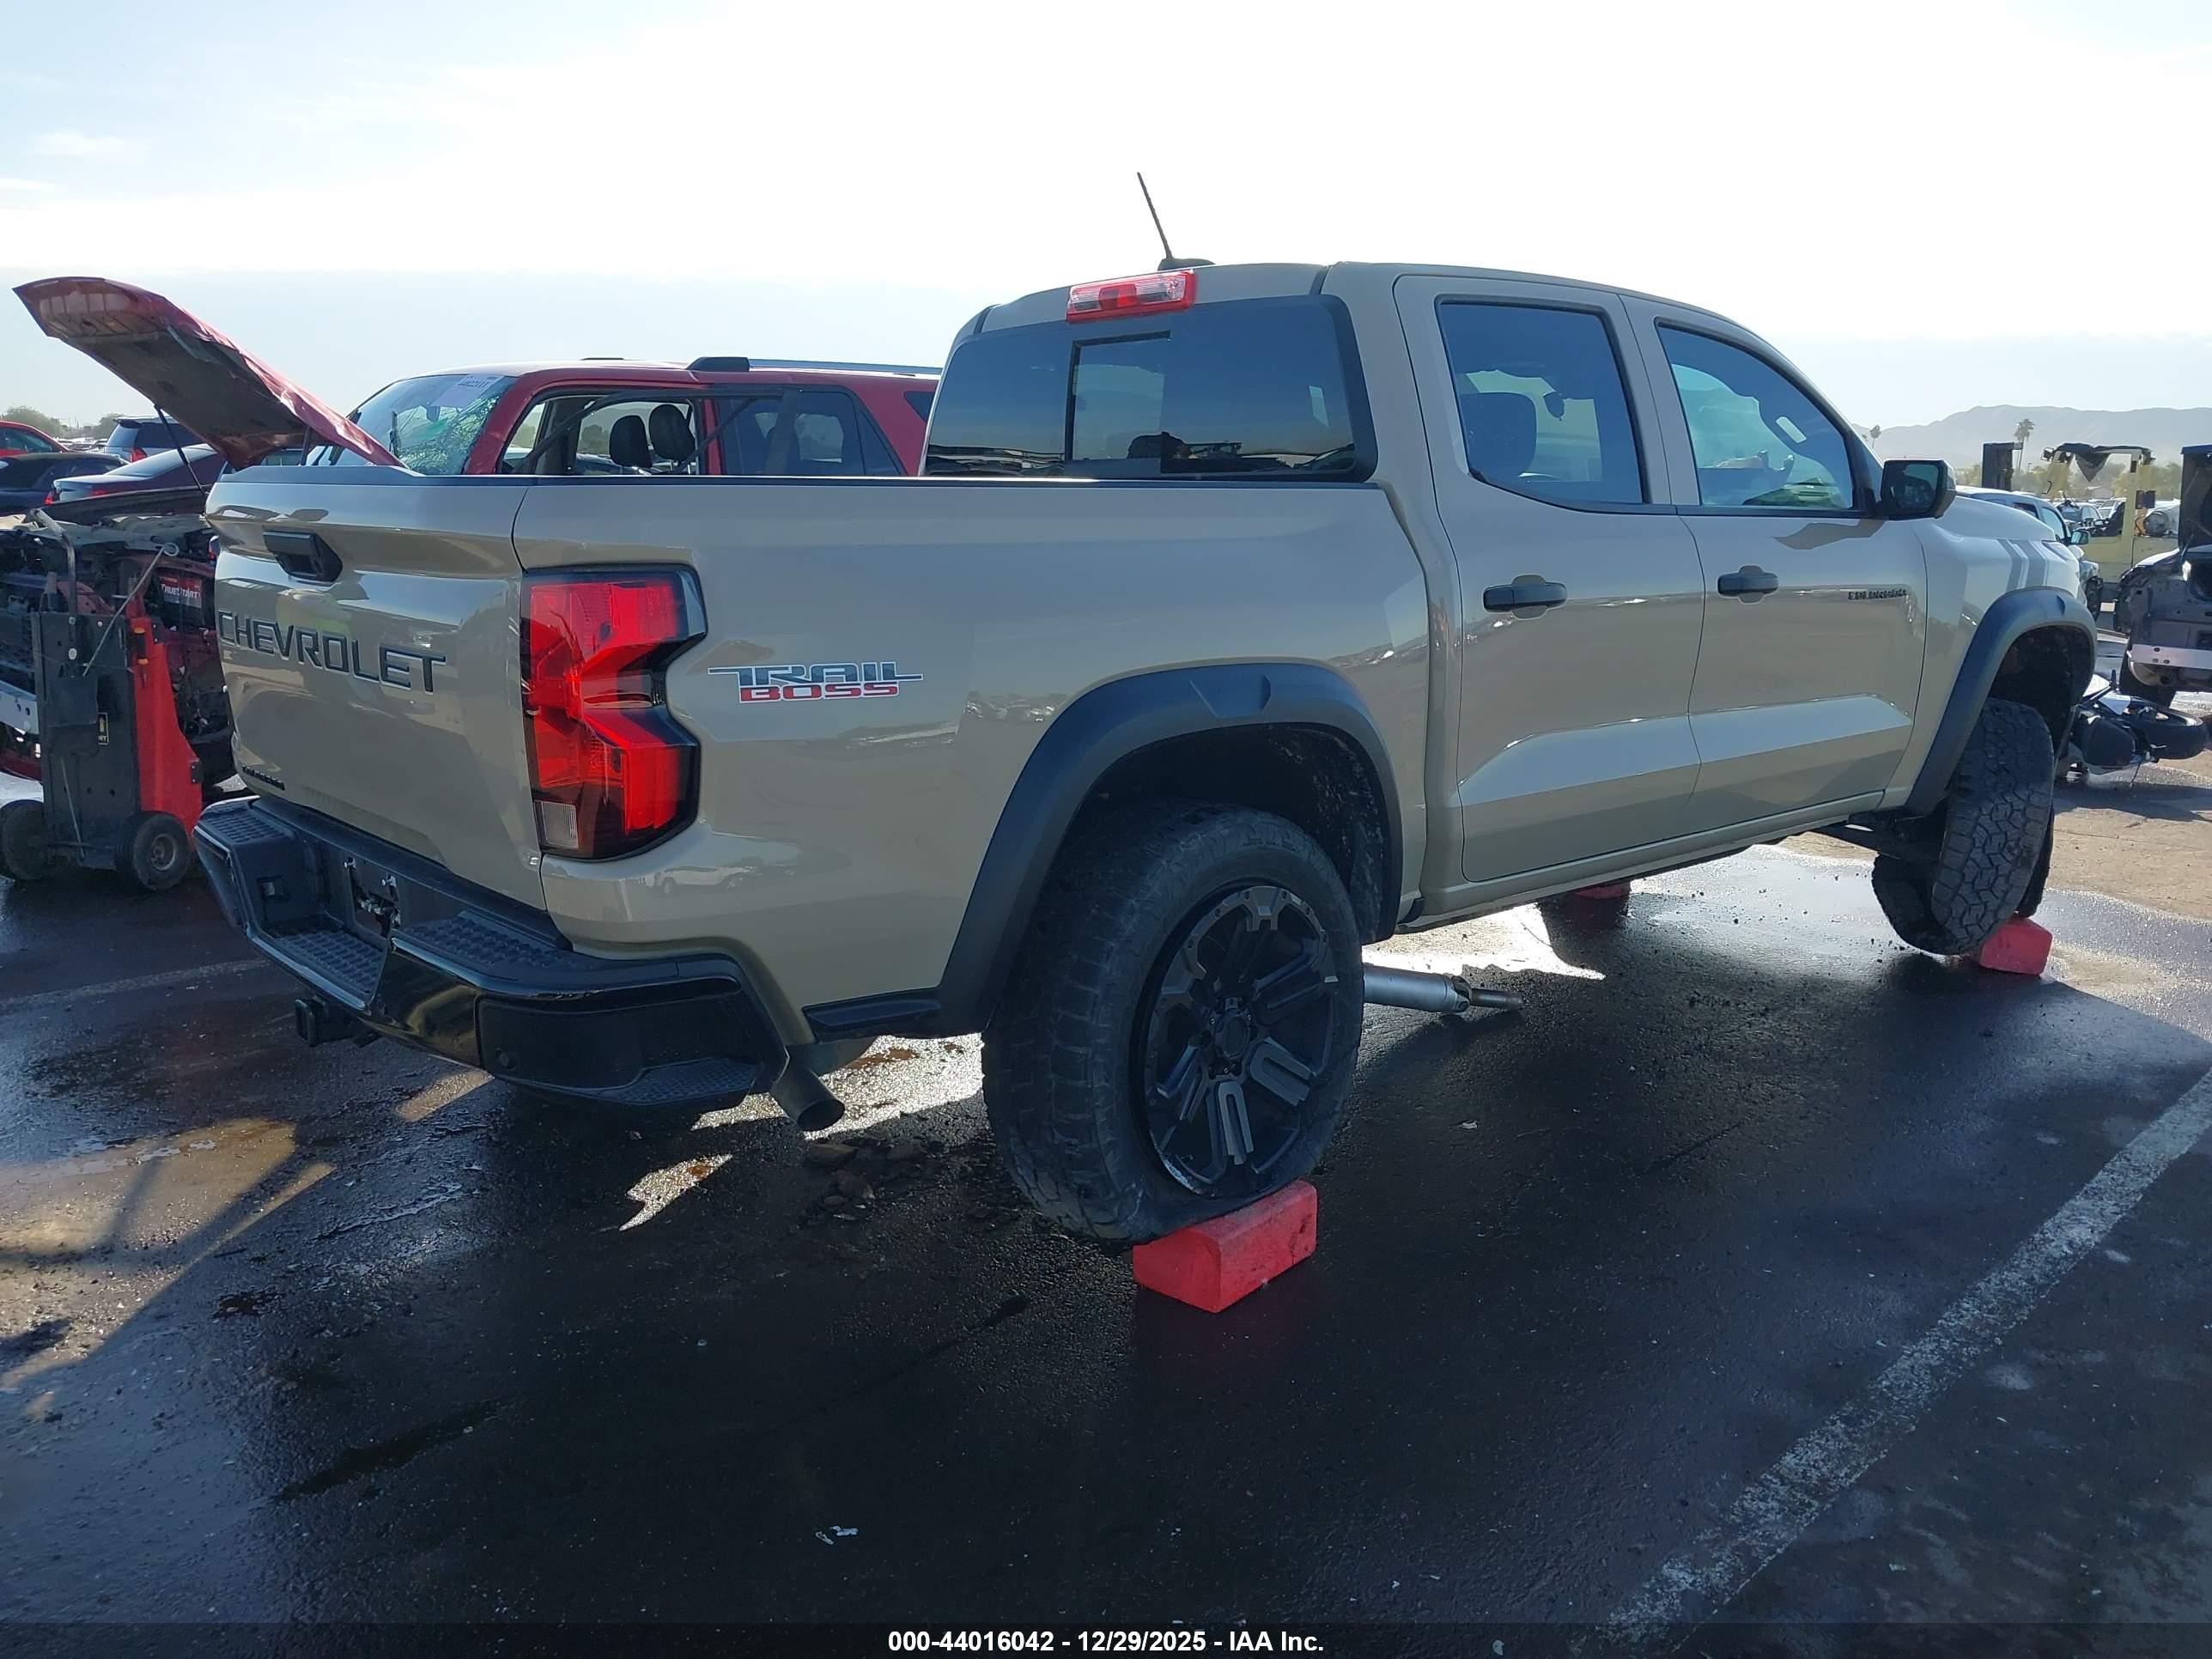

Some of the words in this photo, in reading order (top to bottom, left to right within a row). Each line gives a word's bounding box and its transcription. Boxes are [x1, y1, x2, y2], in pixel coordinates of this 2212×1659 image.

[218, 610, 447, 696] CHEVROLET
[708, 661, 924, 686] TRAIL
[738, 682, 900, 704] BOSS
